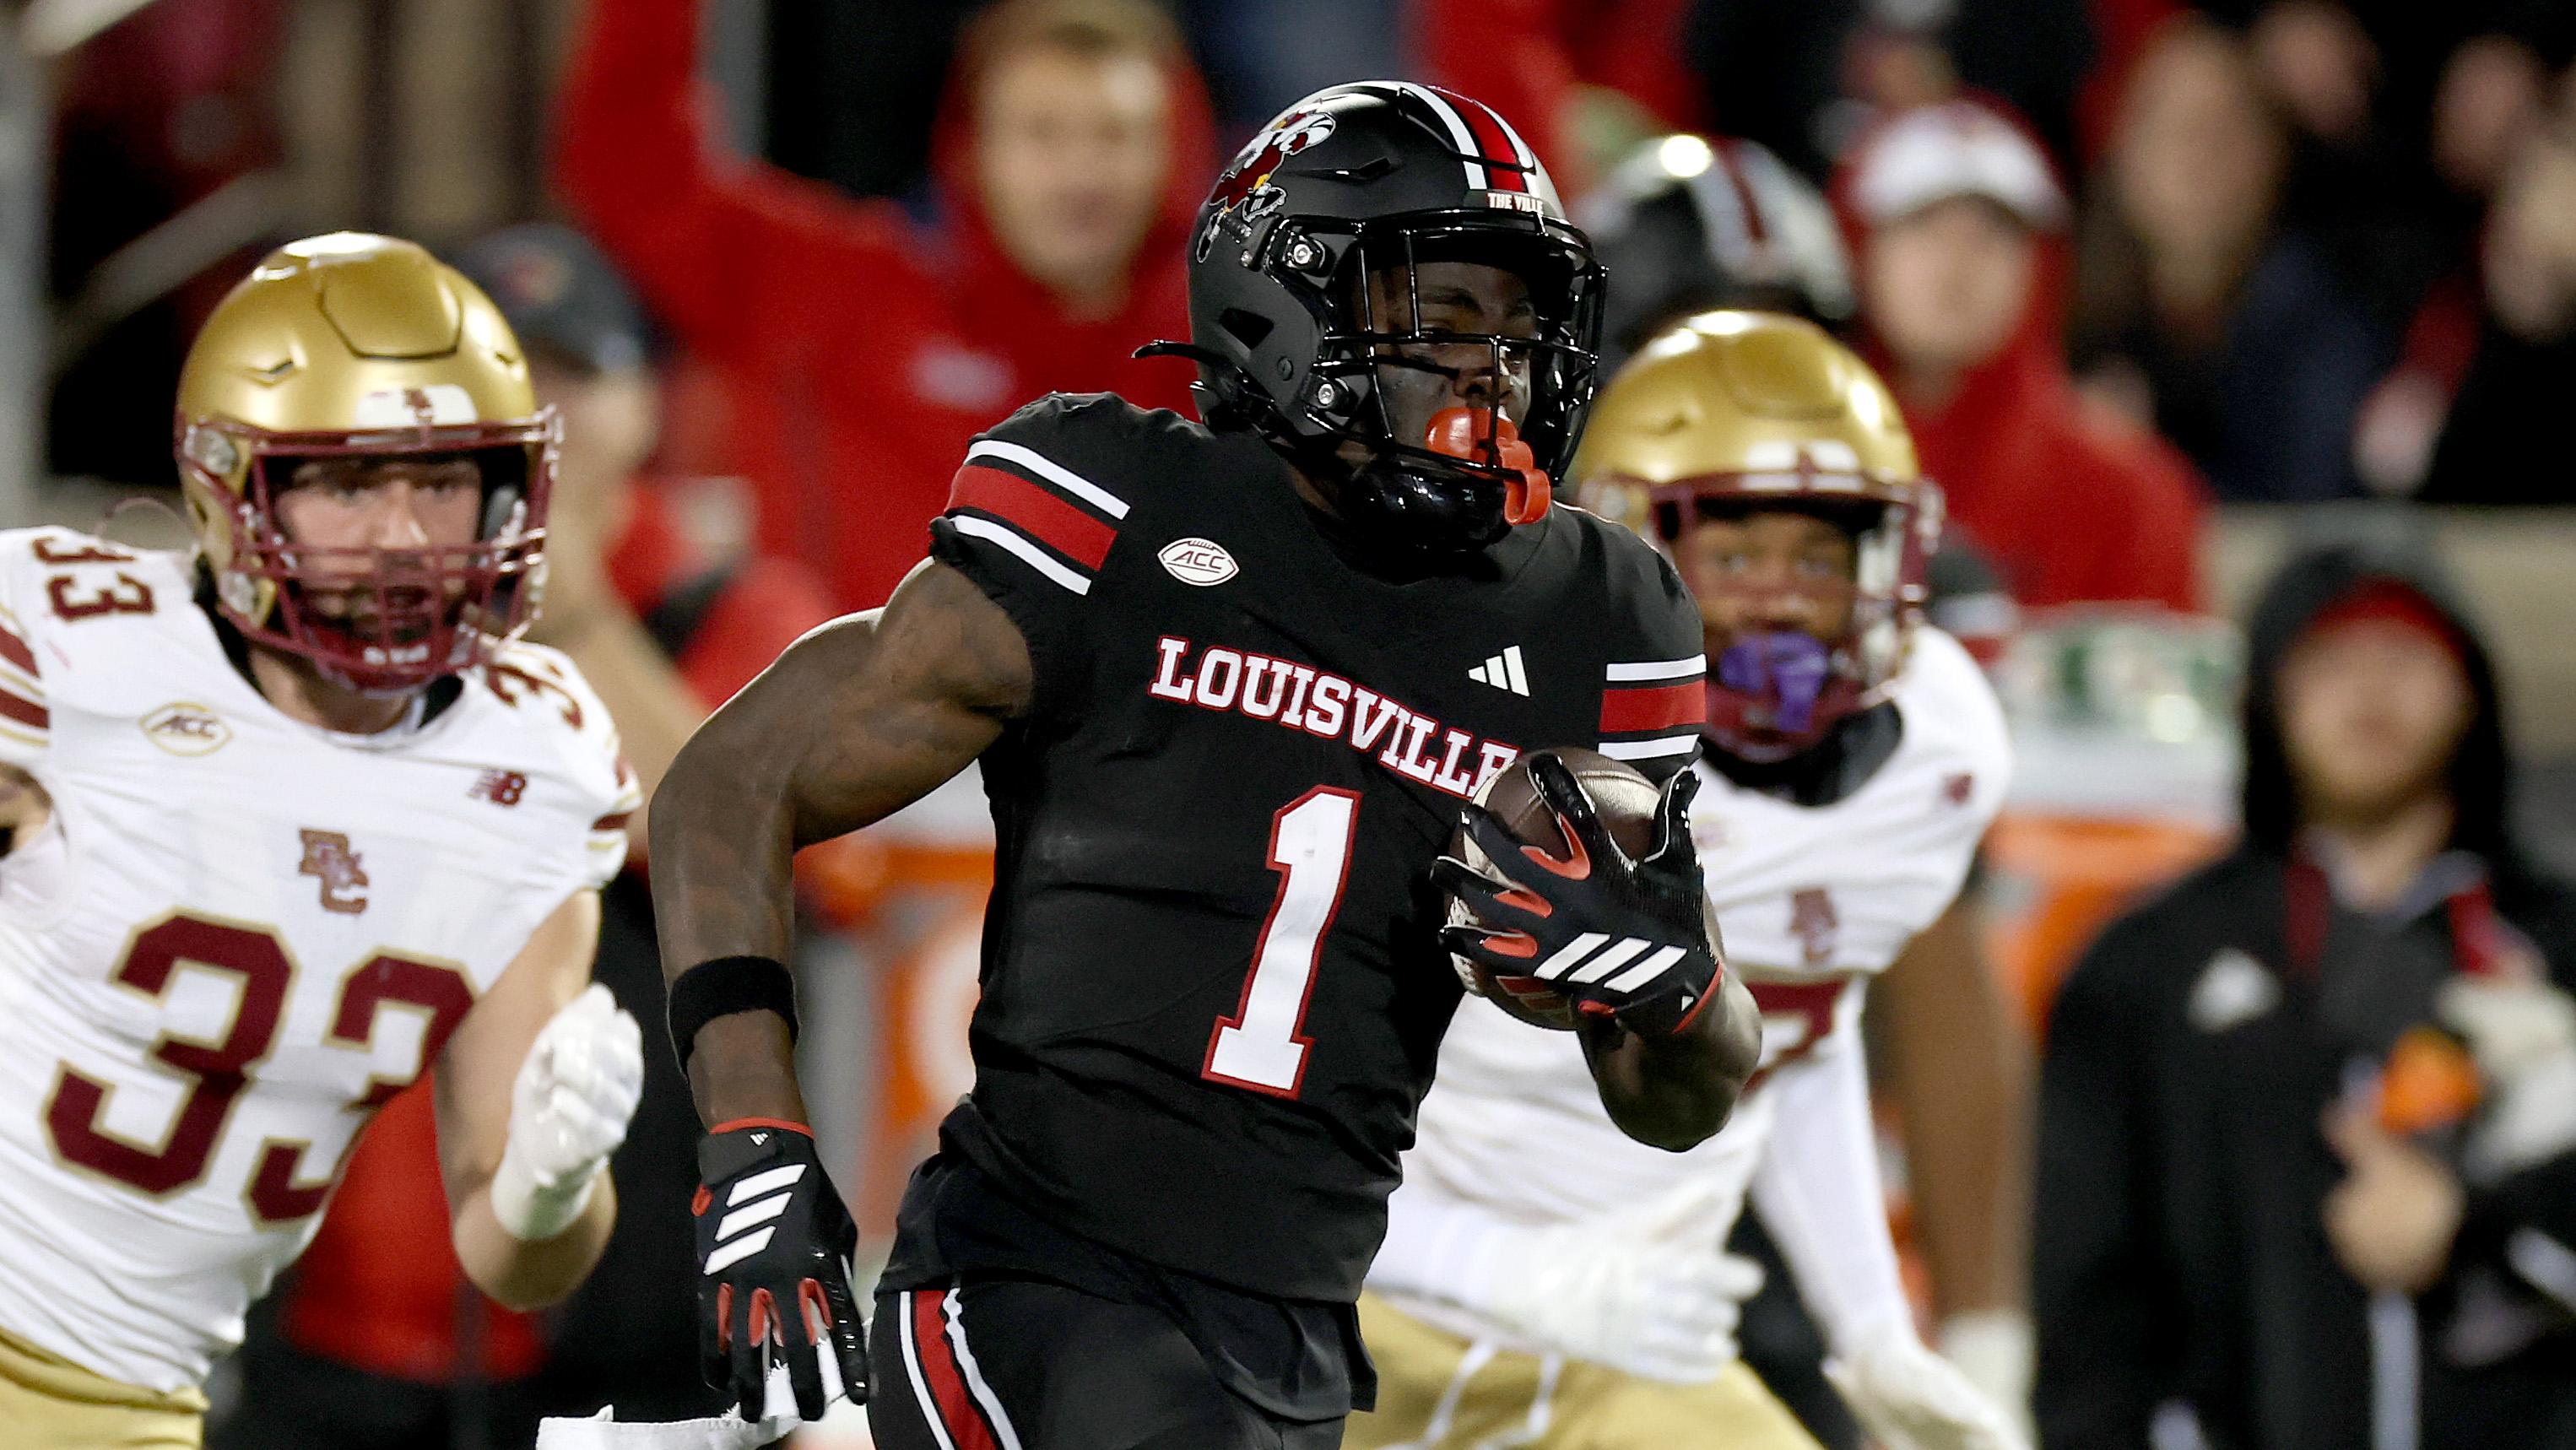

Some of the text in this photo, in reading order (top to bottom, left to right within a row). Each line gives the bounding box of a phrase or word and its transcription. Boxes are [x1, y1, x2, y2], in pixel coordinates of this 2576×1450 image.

[1487, 192, 1544, 215] THE VILLE
[1172, 549, 1226, 571] ACC
[149, 715, 217, 739] ACC
[1201, 784, 1363, 1100] 1
